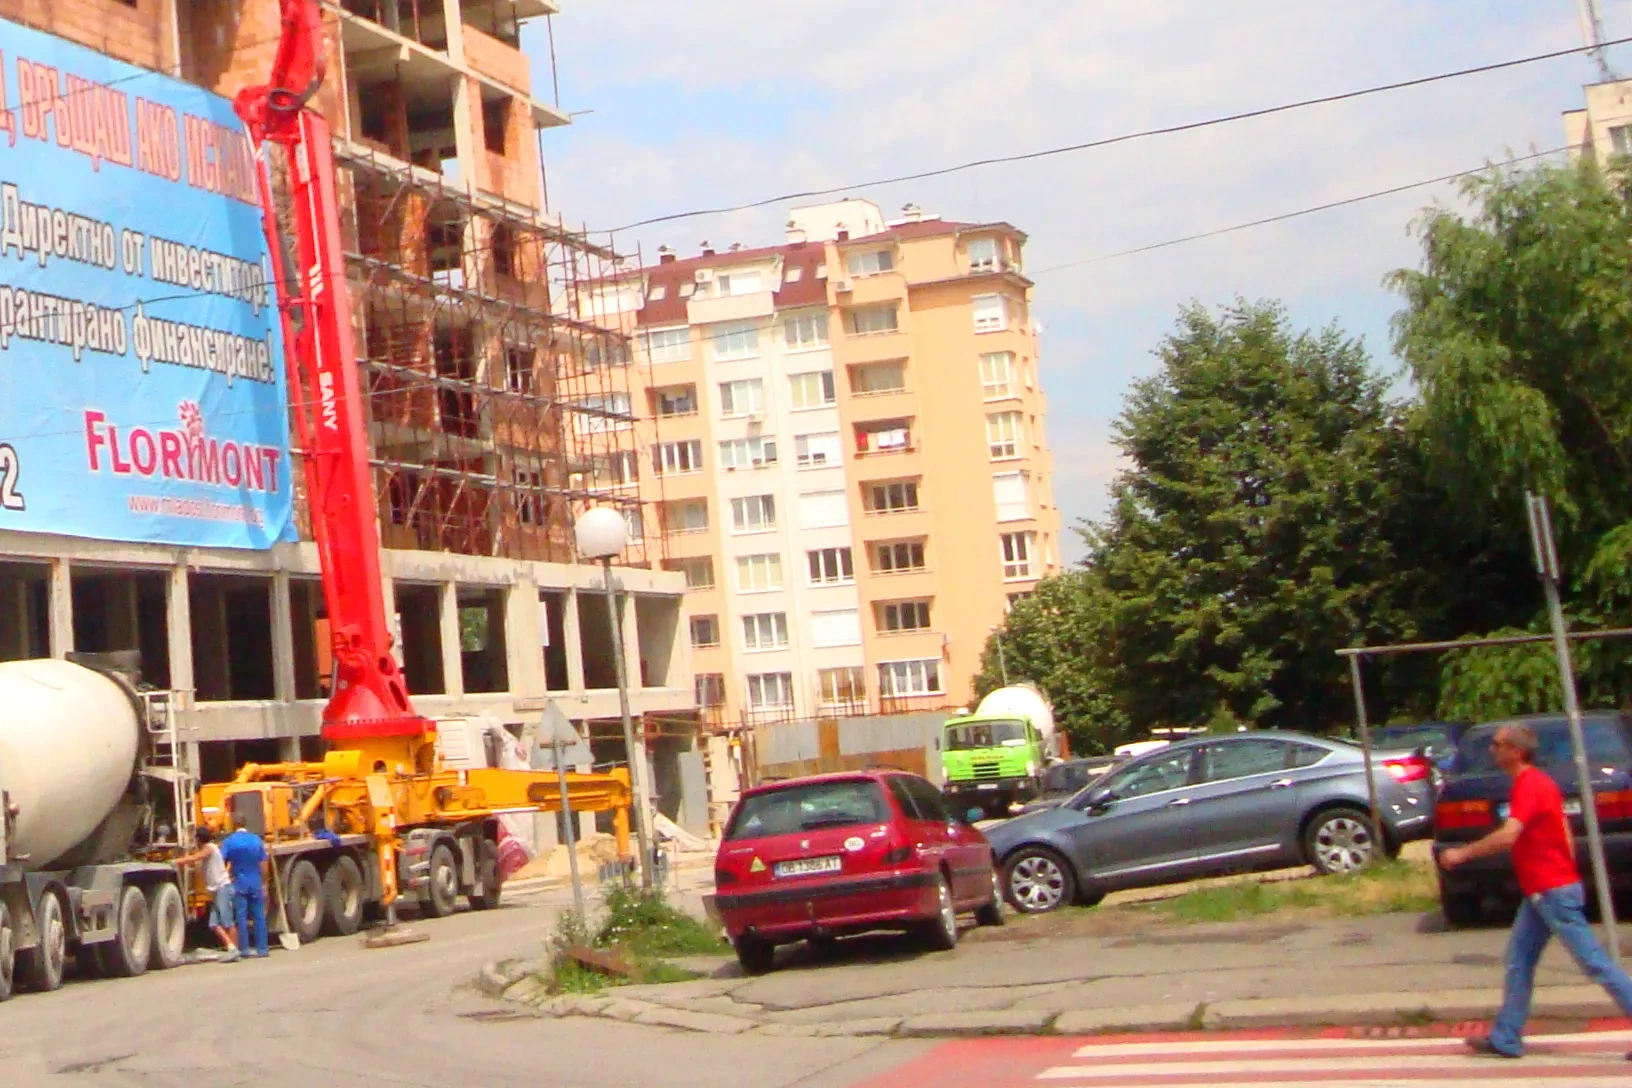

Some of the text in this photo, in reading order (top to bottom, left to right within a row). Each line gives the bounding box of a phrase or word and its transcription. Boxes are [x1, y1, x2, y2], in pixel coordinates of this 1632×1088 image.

[17, 56, 133, 172] ВРЪЩАШ
[135, 96, 181, 183] АКО
[0, 181, 270, 318] Директно от инвеститор!
[132, 299, 276, 389] финансиране!
[319, 371, 338, 430] SANY
